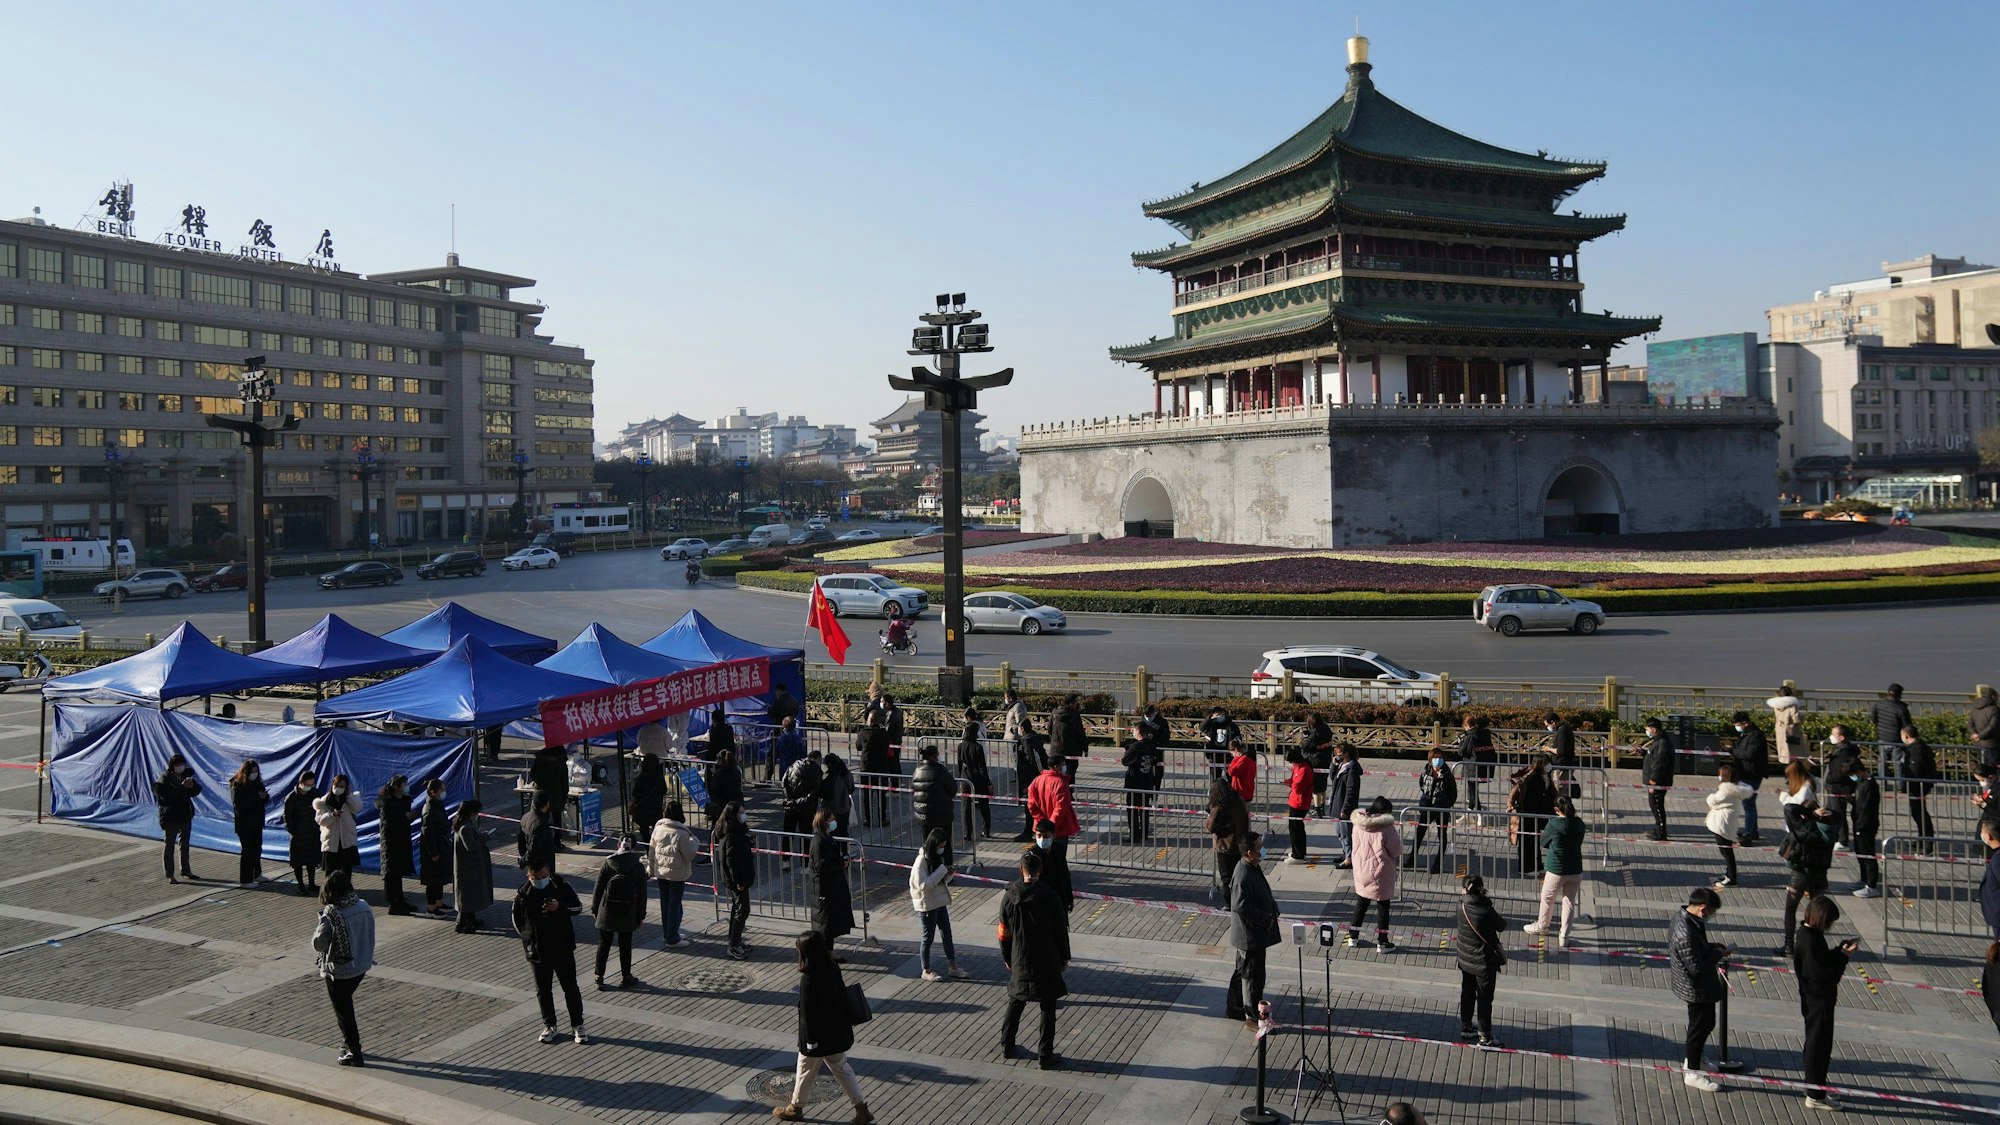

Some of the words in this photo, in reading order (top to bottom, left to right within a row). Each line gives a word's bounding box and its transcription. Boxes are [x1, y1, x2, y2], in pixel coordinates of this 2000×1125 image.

[97, 220, 137, 238] BELL
[165, 232, 222, 252] TOWER
[240, 245, 283, 262] HOTEL
[307, 257, 341, 272] XIAN
[563, 663, 763, 733] 柏树林街道三学街社区核酸检测点
